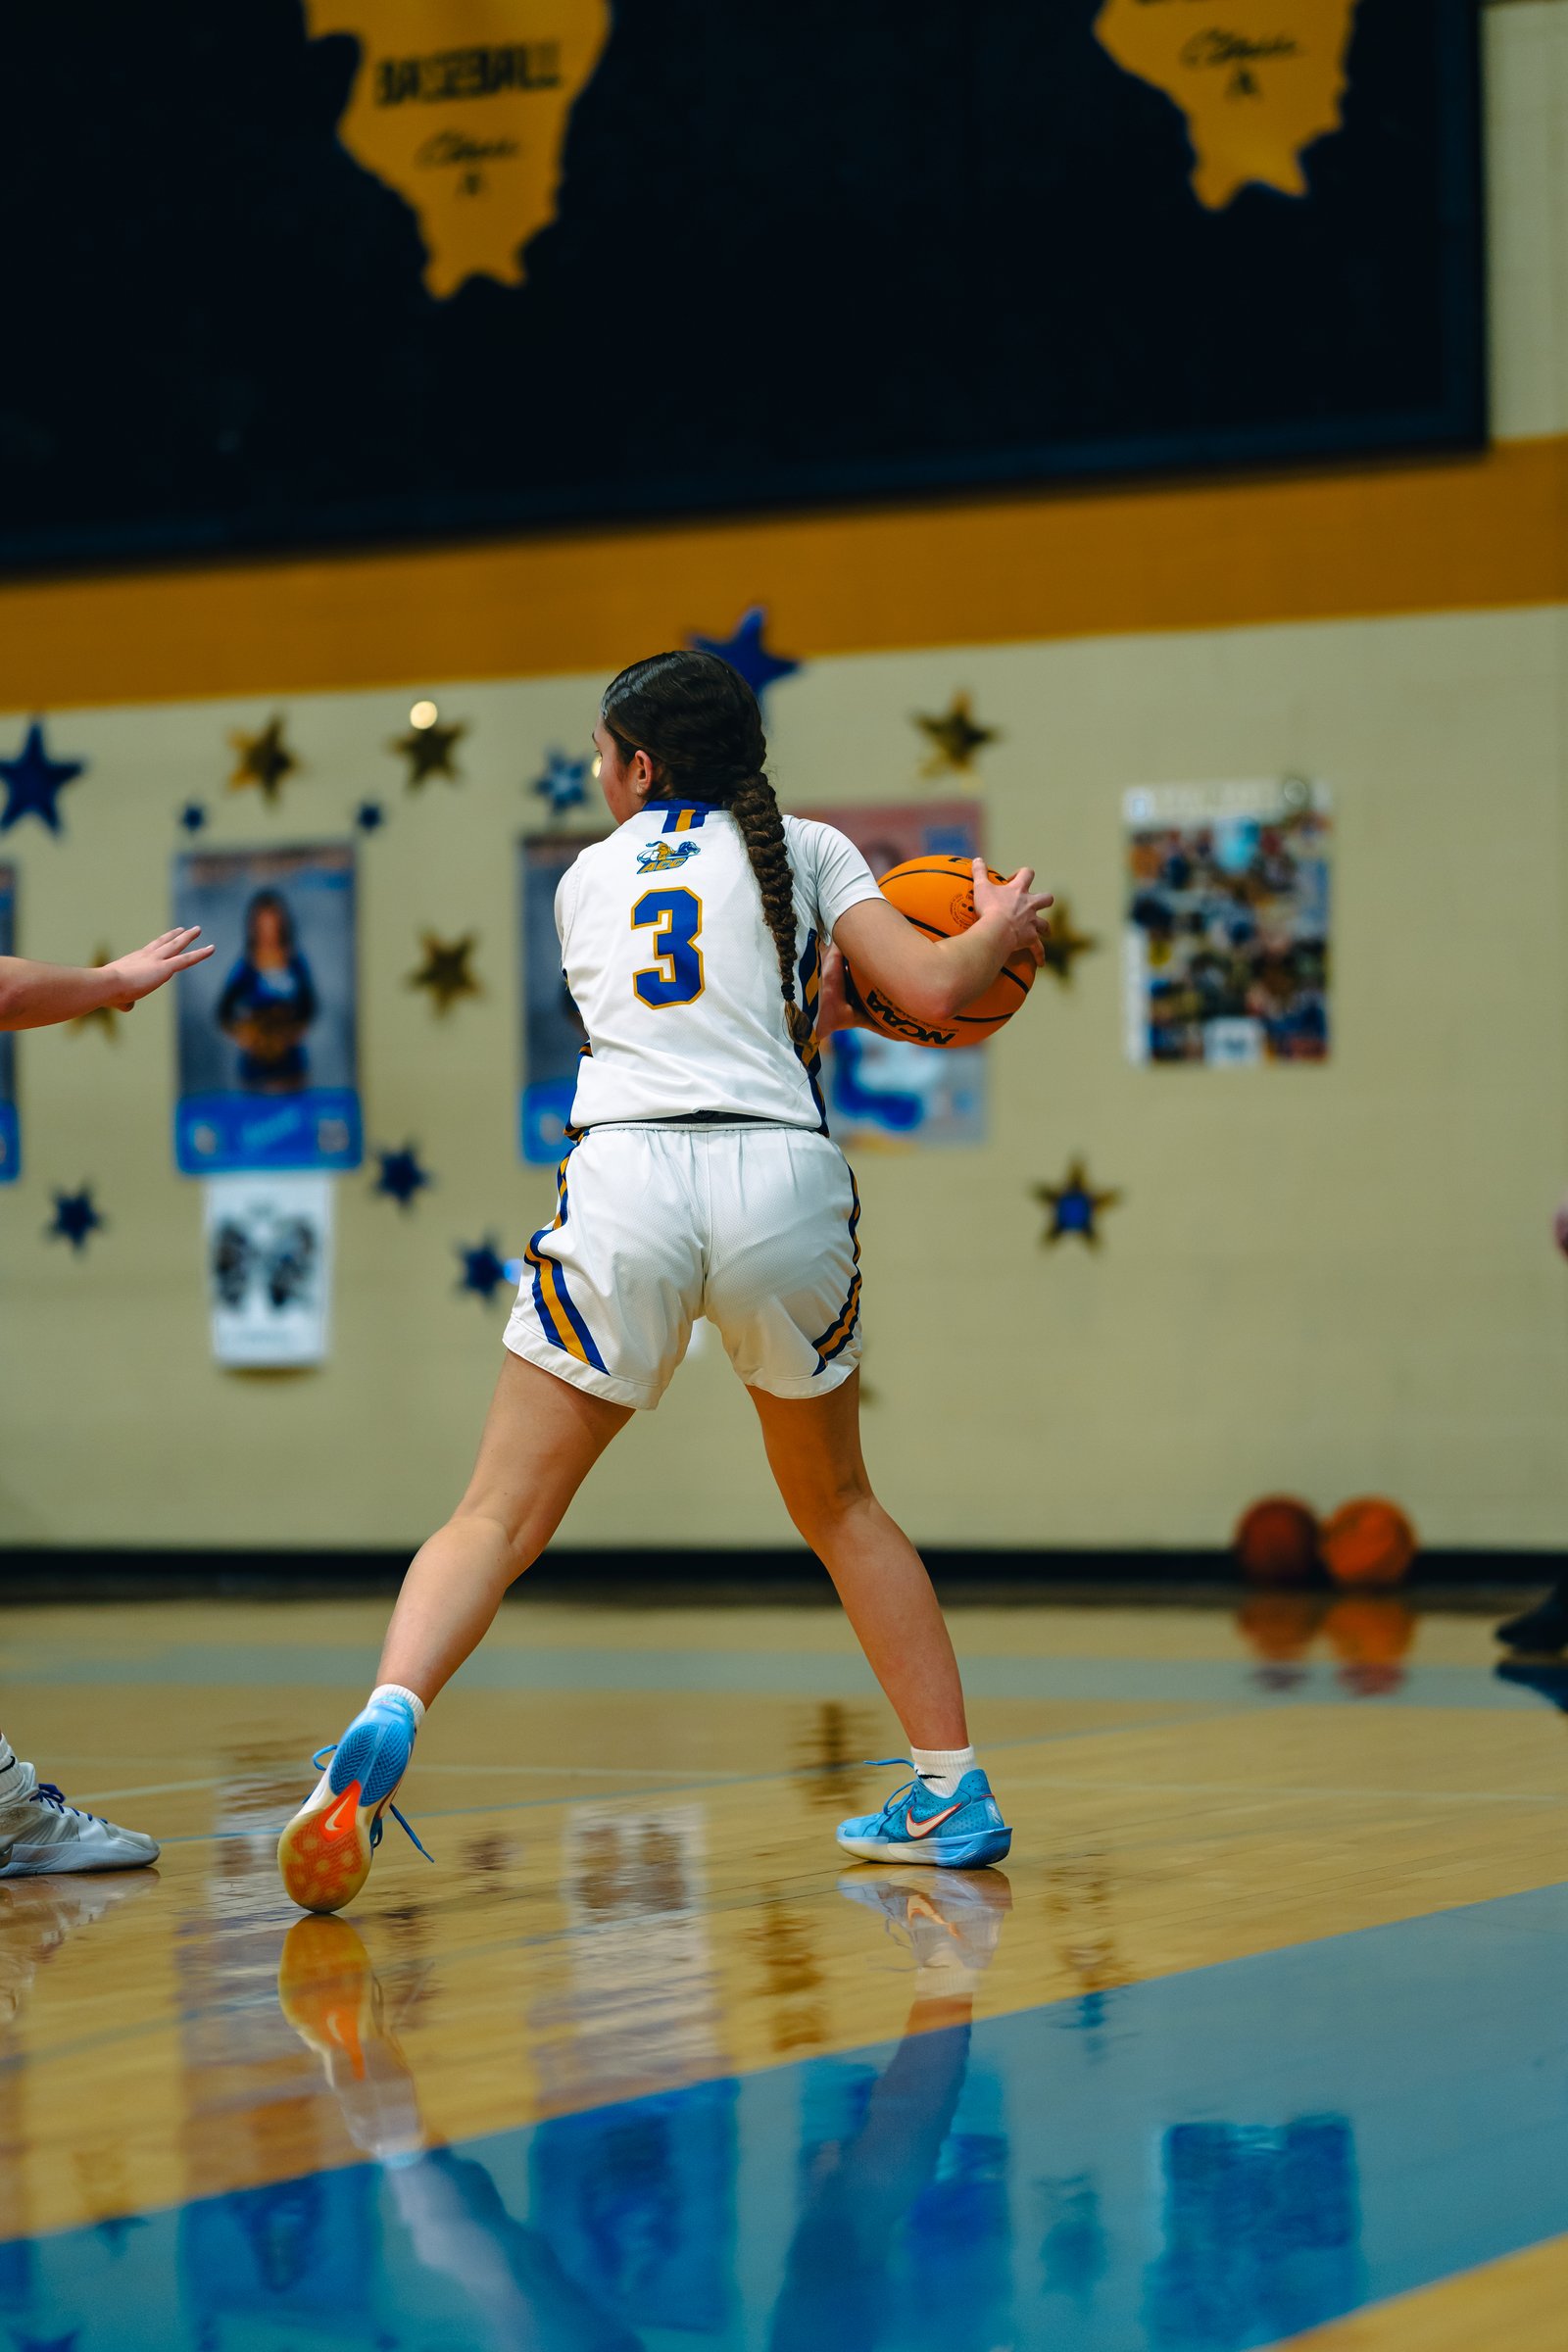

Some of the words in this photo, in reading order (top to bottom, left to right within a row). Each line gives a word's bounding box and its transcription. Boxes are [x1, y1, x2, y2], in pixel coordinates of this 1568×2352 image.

[375, 42, 561, 109] BASEBALL
[630, 886, 706, 1009] 3
[866, 989, 956, 1046] NCAA
